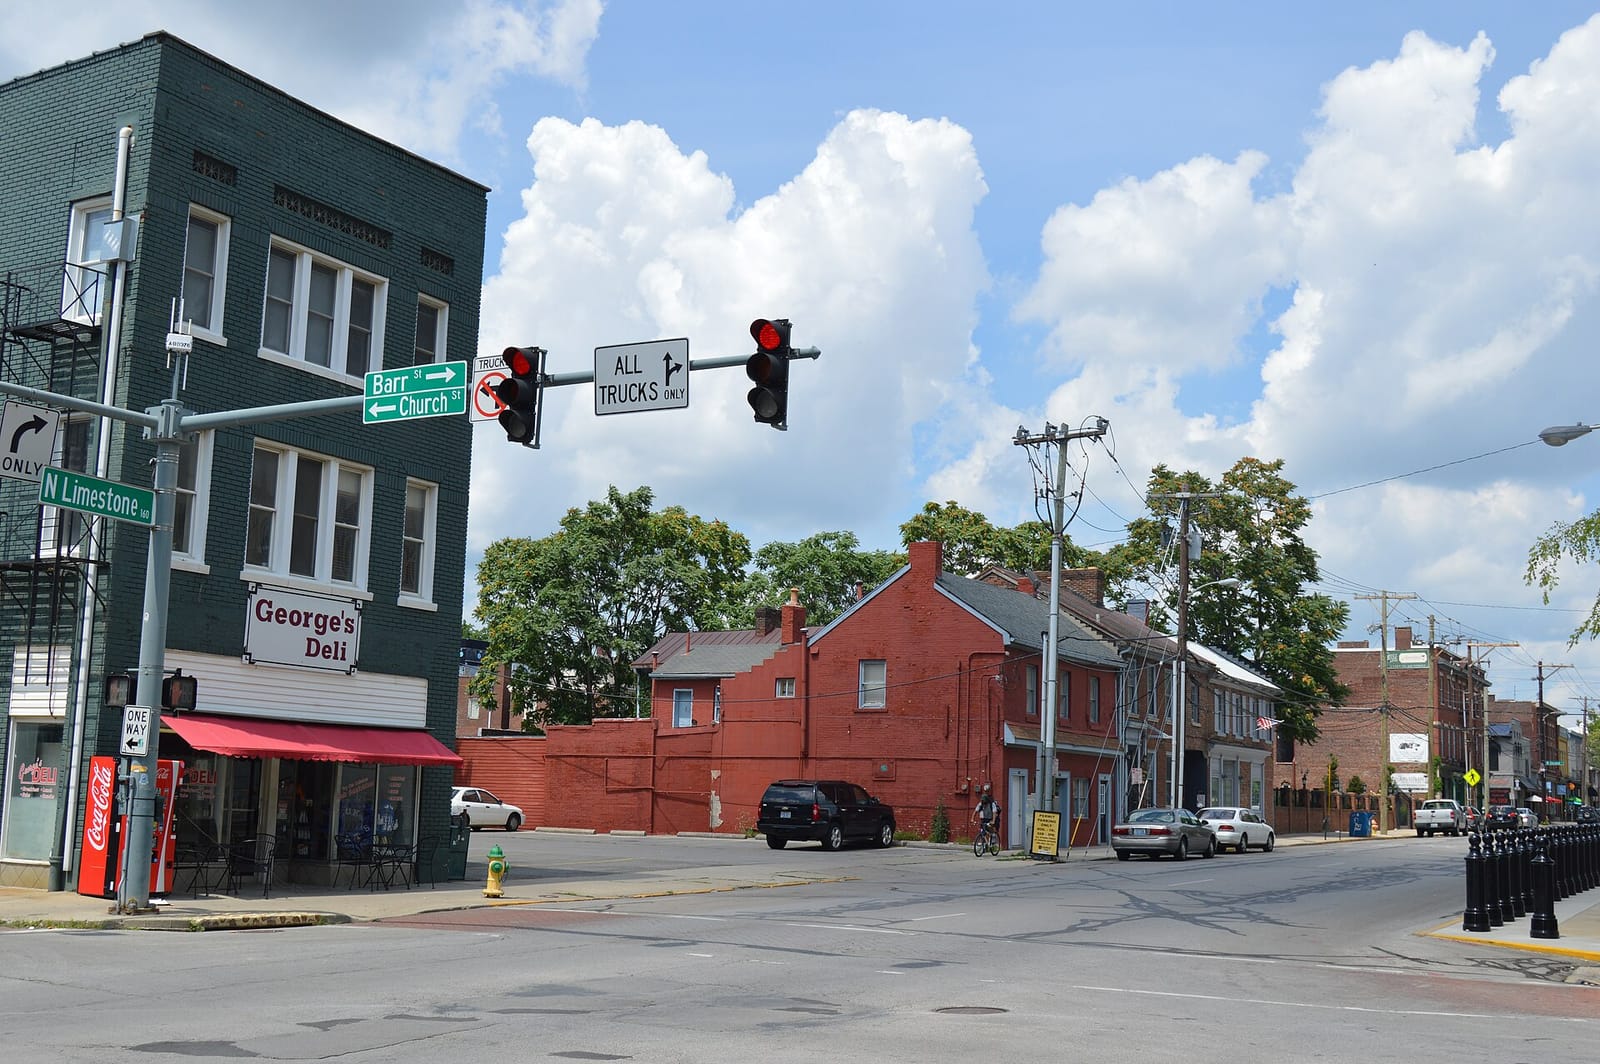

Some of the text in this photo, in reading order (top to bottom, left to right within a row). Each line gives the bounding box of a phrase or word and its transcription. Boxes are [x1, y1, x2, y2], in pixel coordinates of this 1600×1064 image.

[479, 356, 505, 369] TRUCK
[614, 354, 643, 376] ALL
[373, 369, 422, 395] Barr St
[599, 381, 685, 405] TRUCKS ONLY
[399, 390, 461, 416] Church St
[2, 456, 43, 477] ONLY
[44, 472, 58, 500] N
[61, 476, 138, 517] Limestone
[255, 598, 355, 635] George's
[305, 637, 347, 661] Deli
[128, 710, 148, 722] ONE
[126, 723, 147, 735] WAY
[31, 766, 58, 783] DELI
[190, 769, 217, 784] DELI
